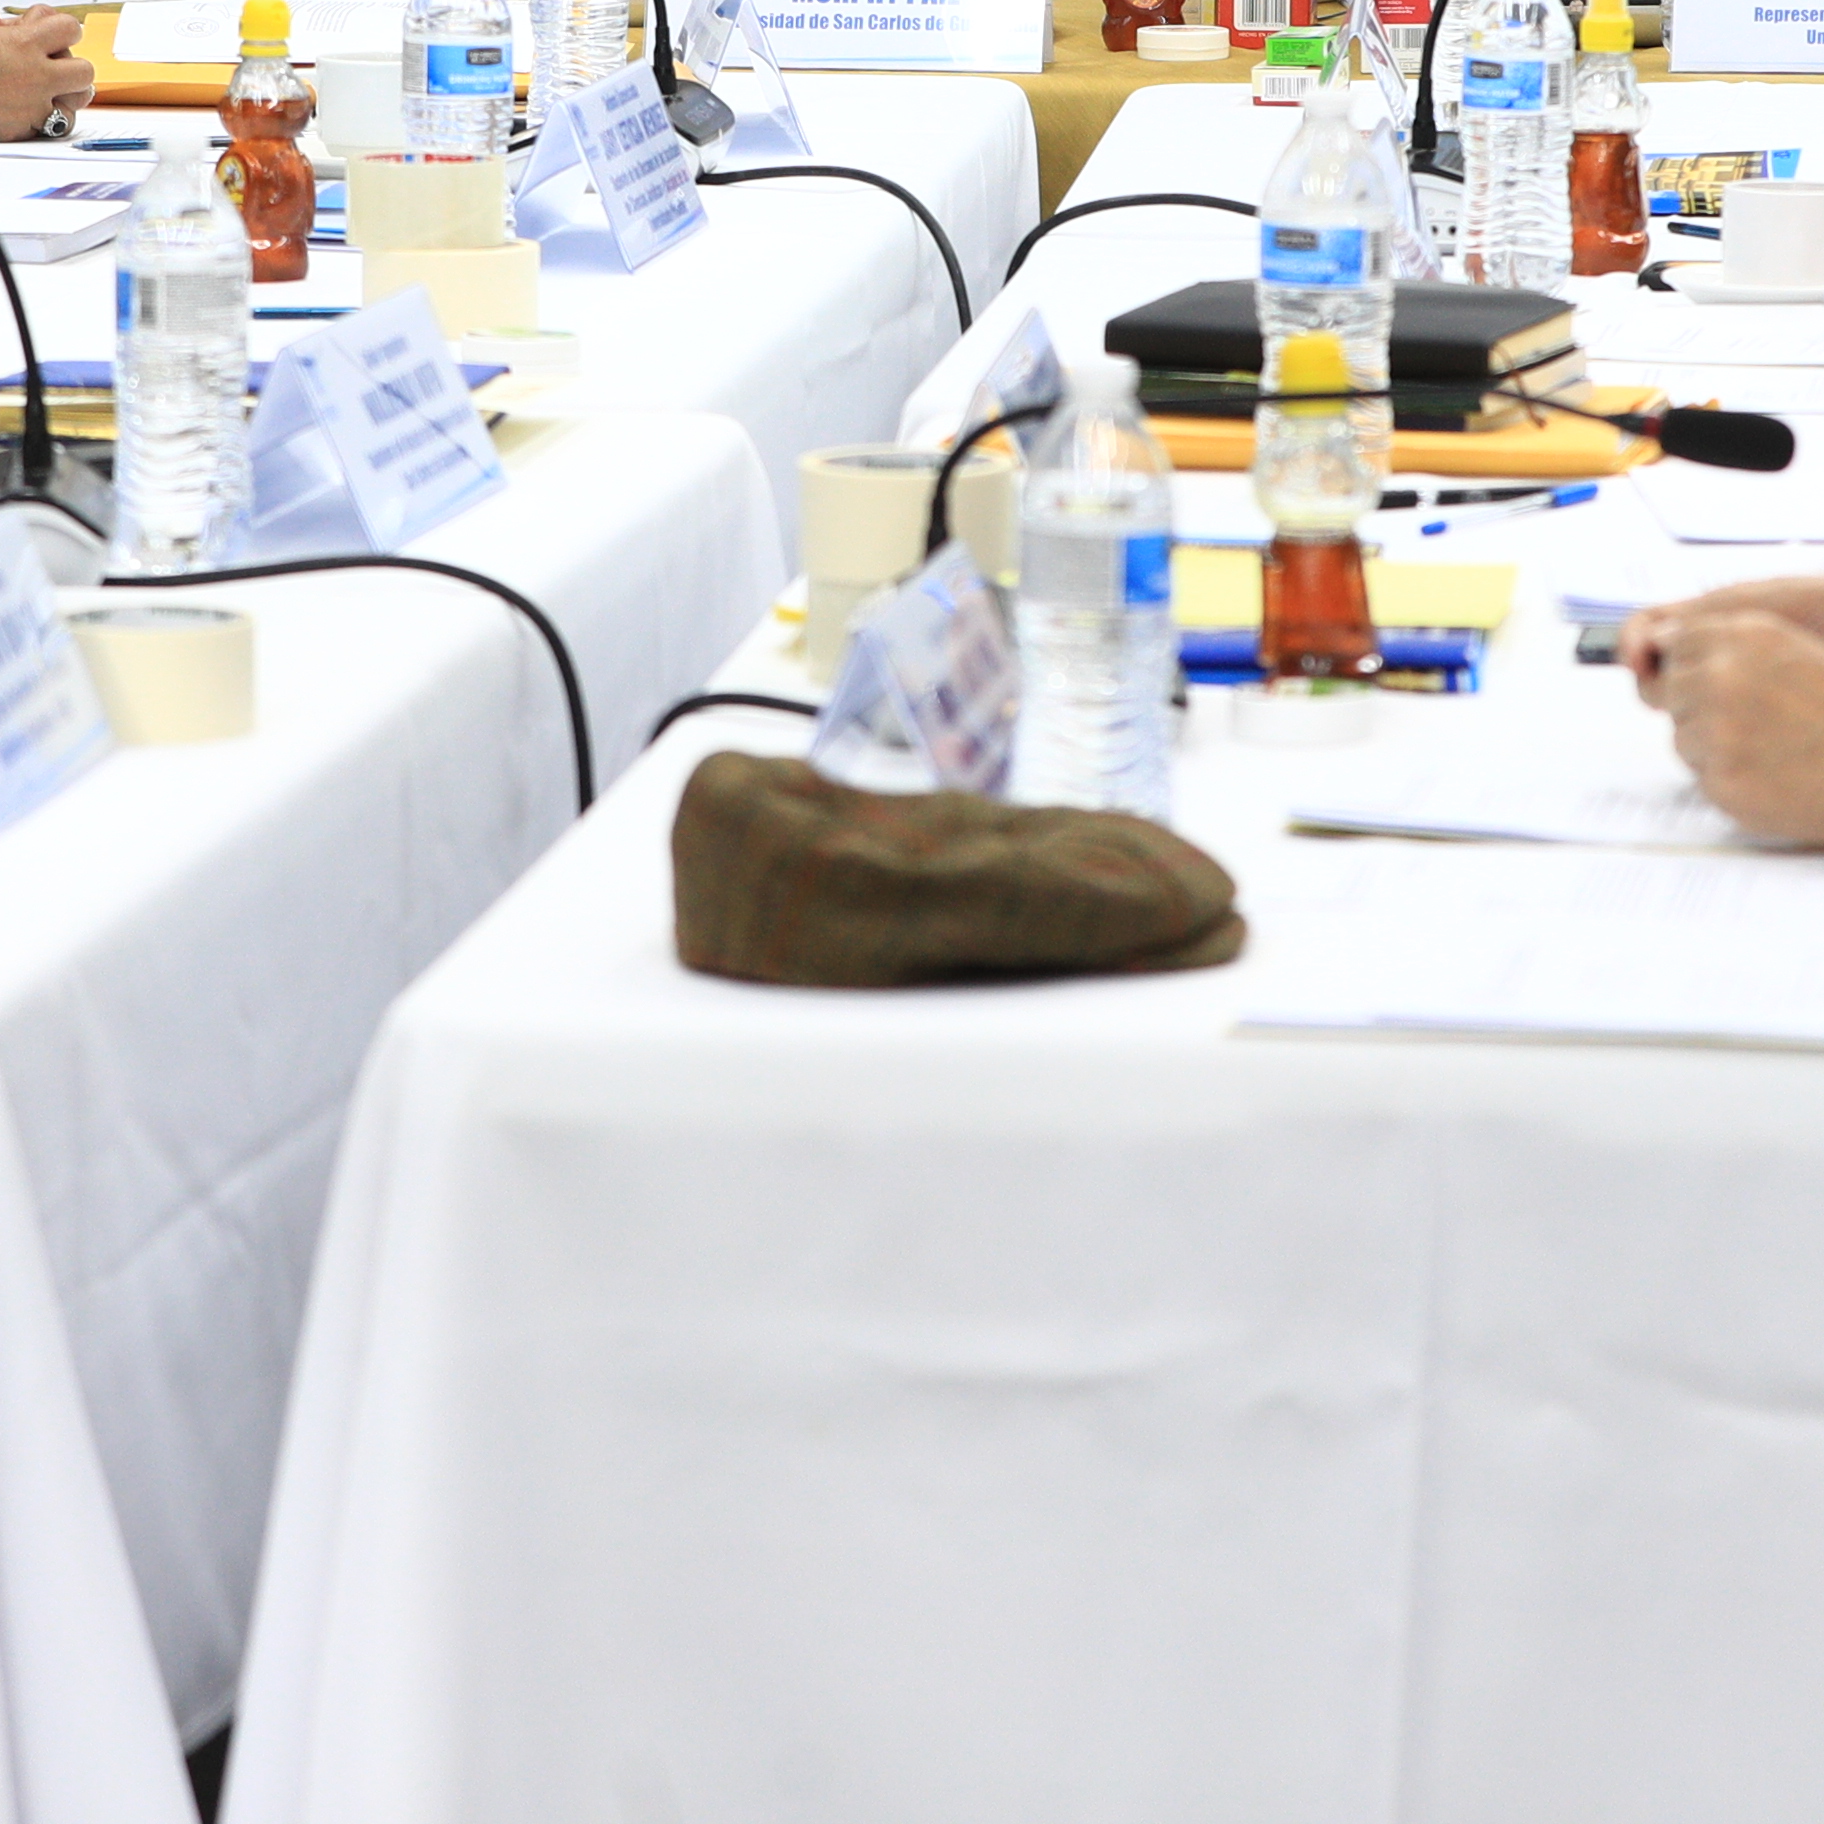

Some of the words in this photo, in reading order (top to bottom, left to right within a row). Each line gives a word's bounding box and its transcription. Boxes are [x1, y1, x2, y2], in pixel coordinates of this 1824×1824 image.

[808, 13, 829, 29] de
[833, 13, 864, 30] San
[868, 14, 921, 31] Carlos
[925, 15, 945, 31] de
